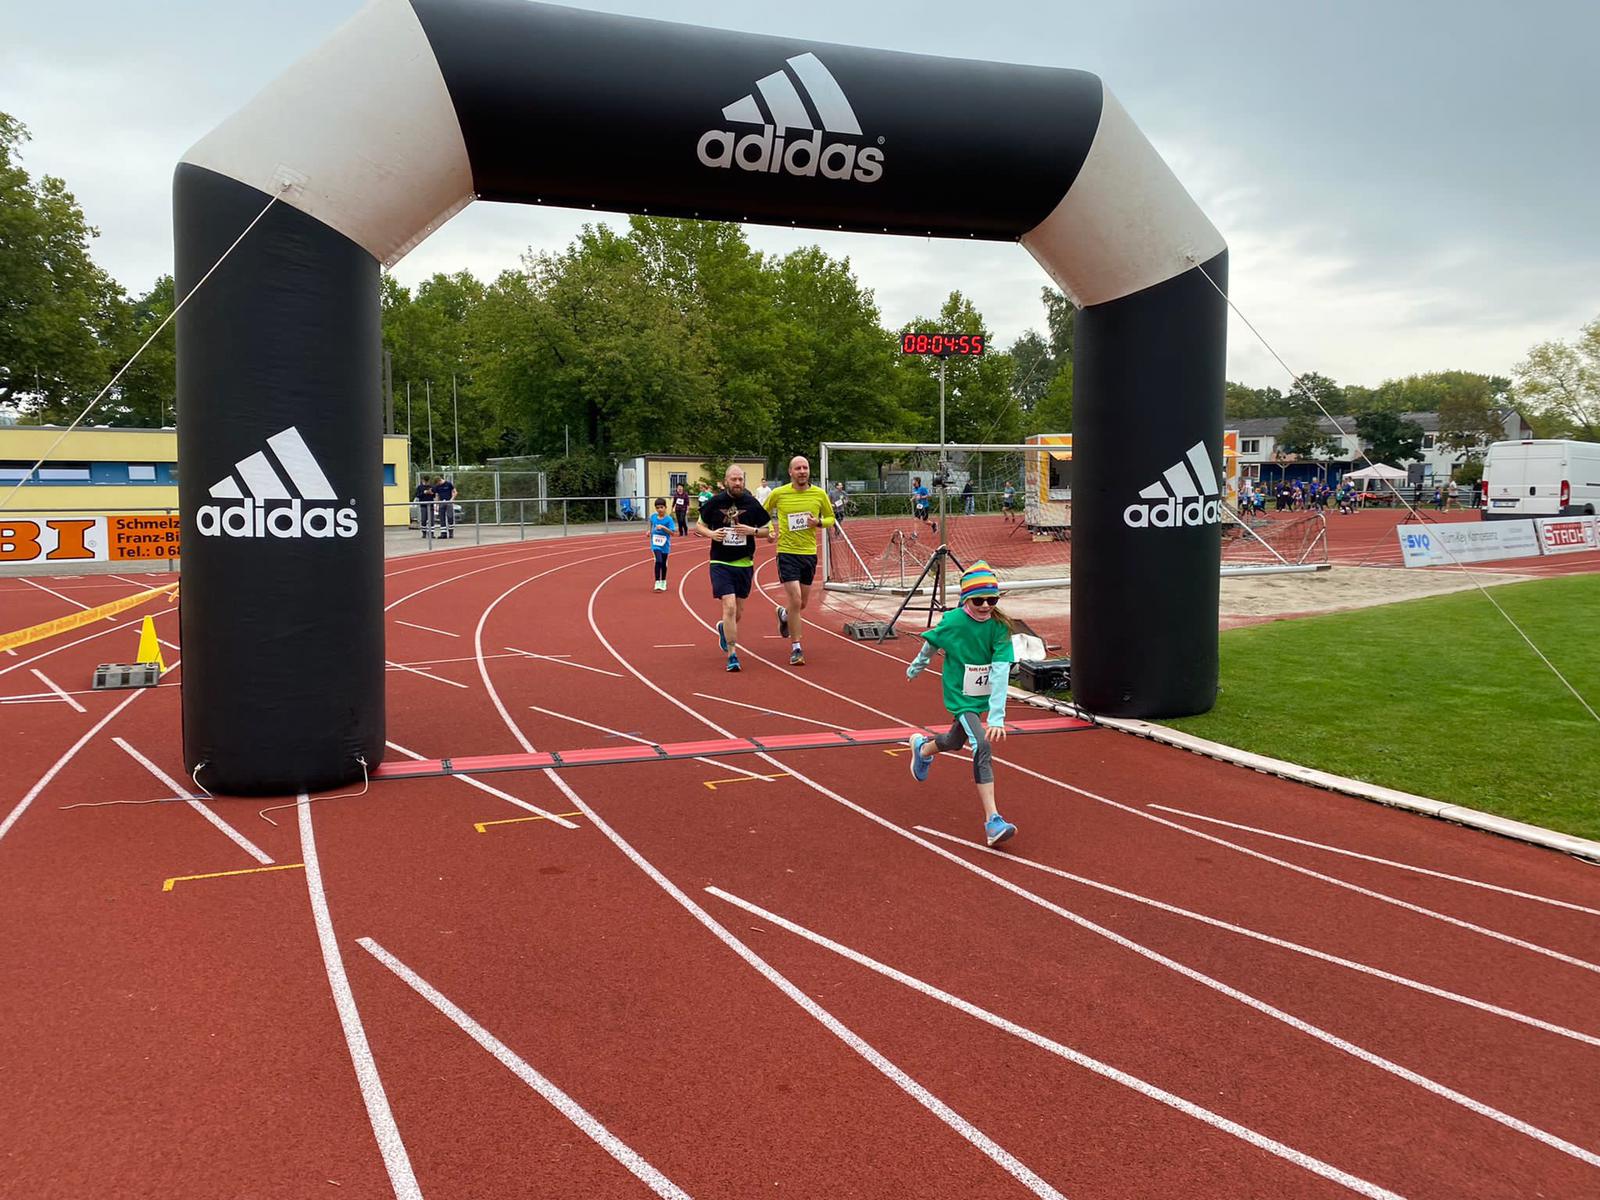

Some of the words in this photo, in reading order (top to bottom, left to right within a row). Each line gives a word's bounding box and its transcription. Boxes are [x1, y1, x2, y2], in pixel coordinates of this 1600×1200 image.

[697, 124, 885, 183] adidas
[904, 335, 983, 354] 08:04:55
[196, 498, 358, 538] adidas
[795, 517, 805, 525] 60
[118, 547, 150, 558] Tel.:
